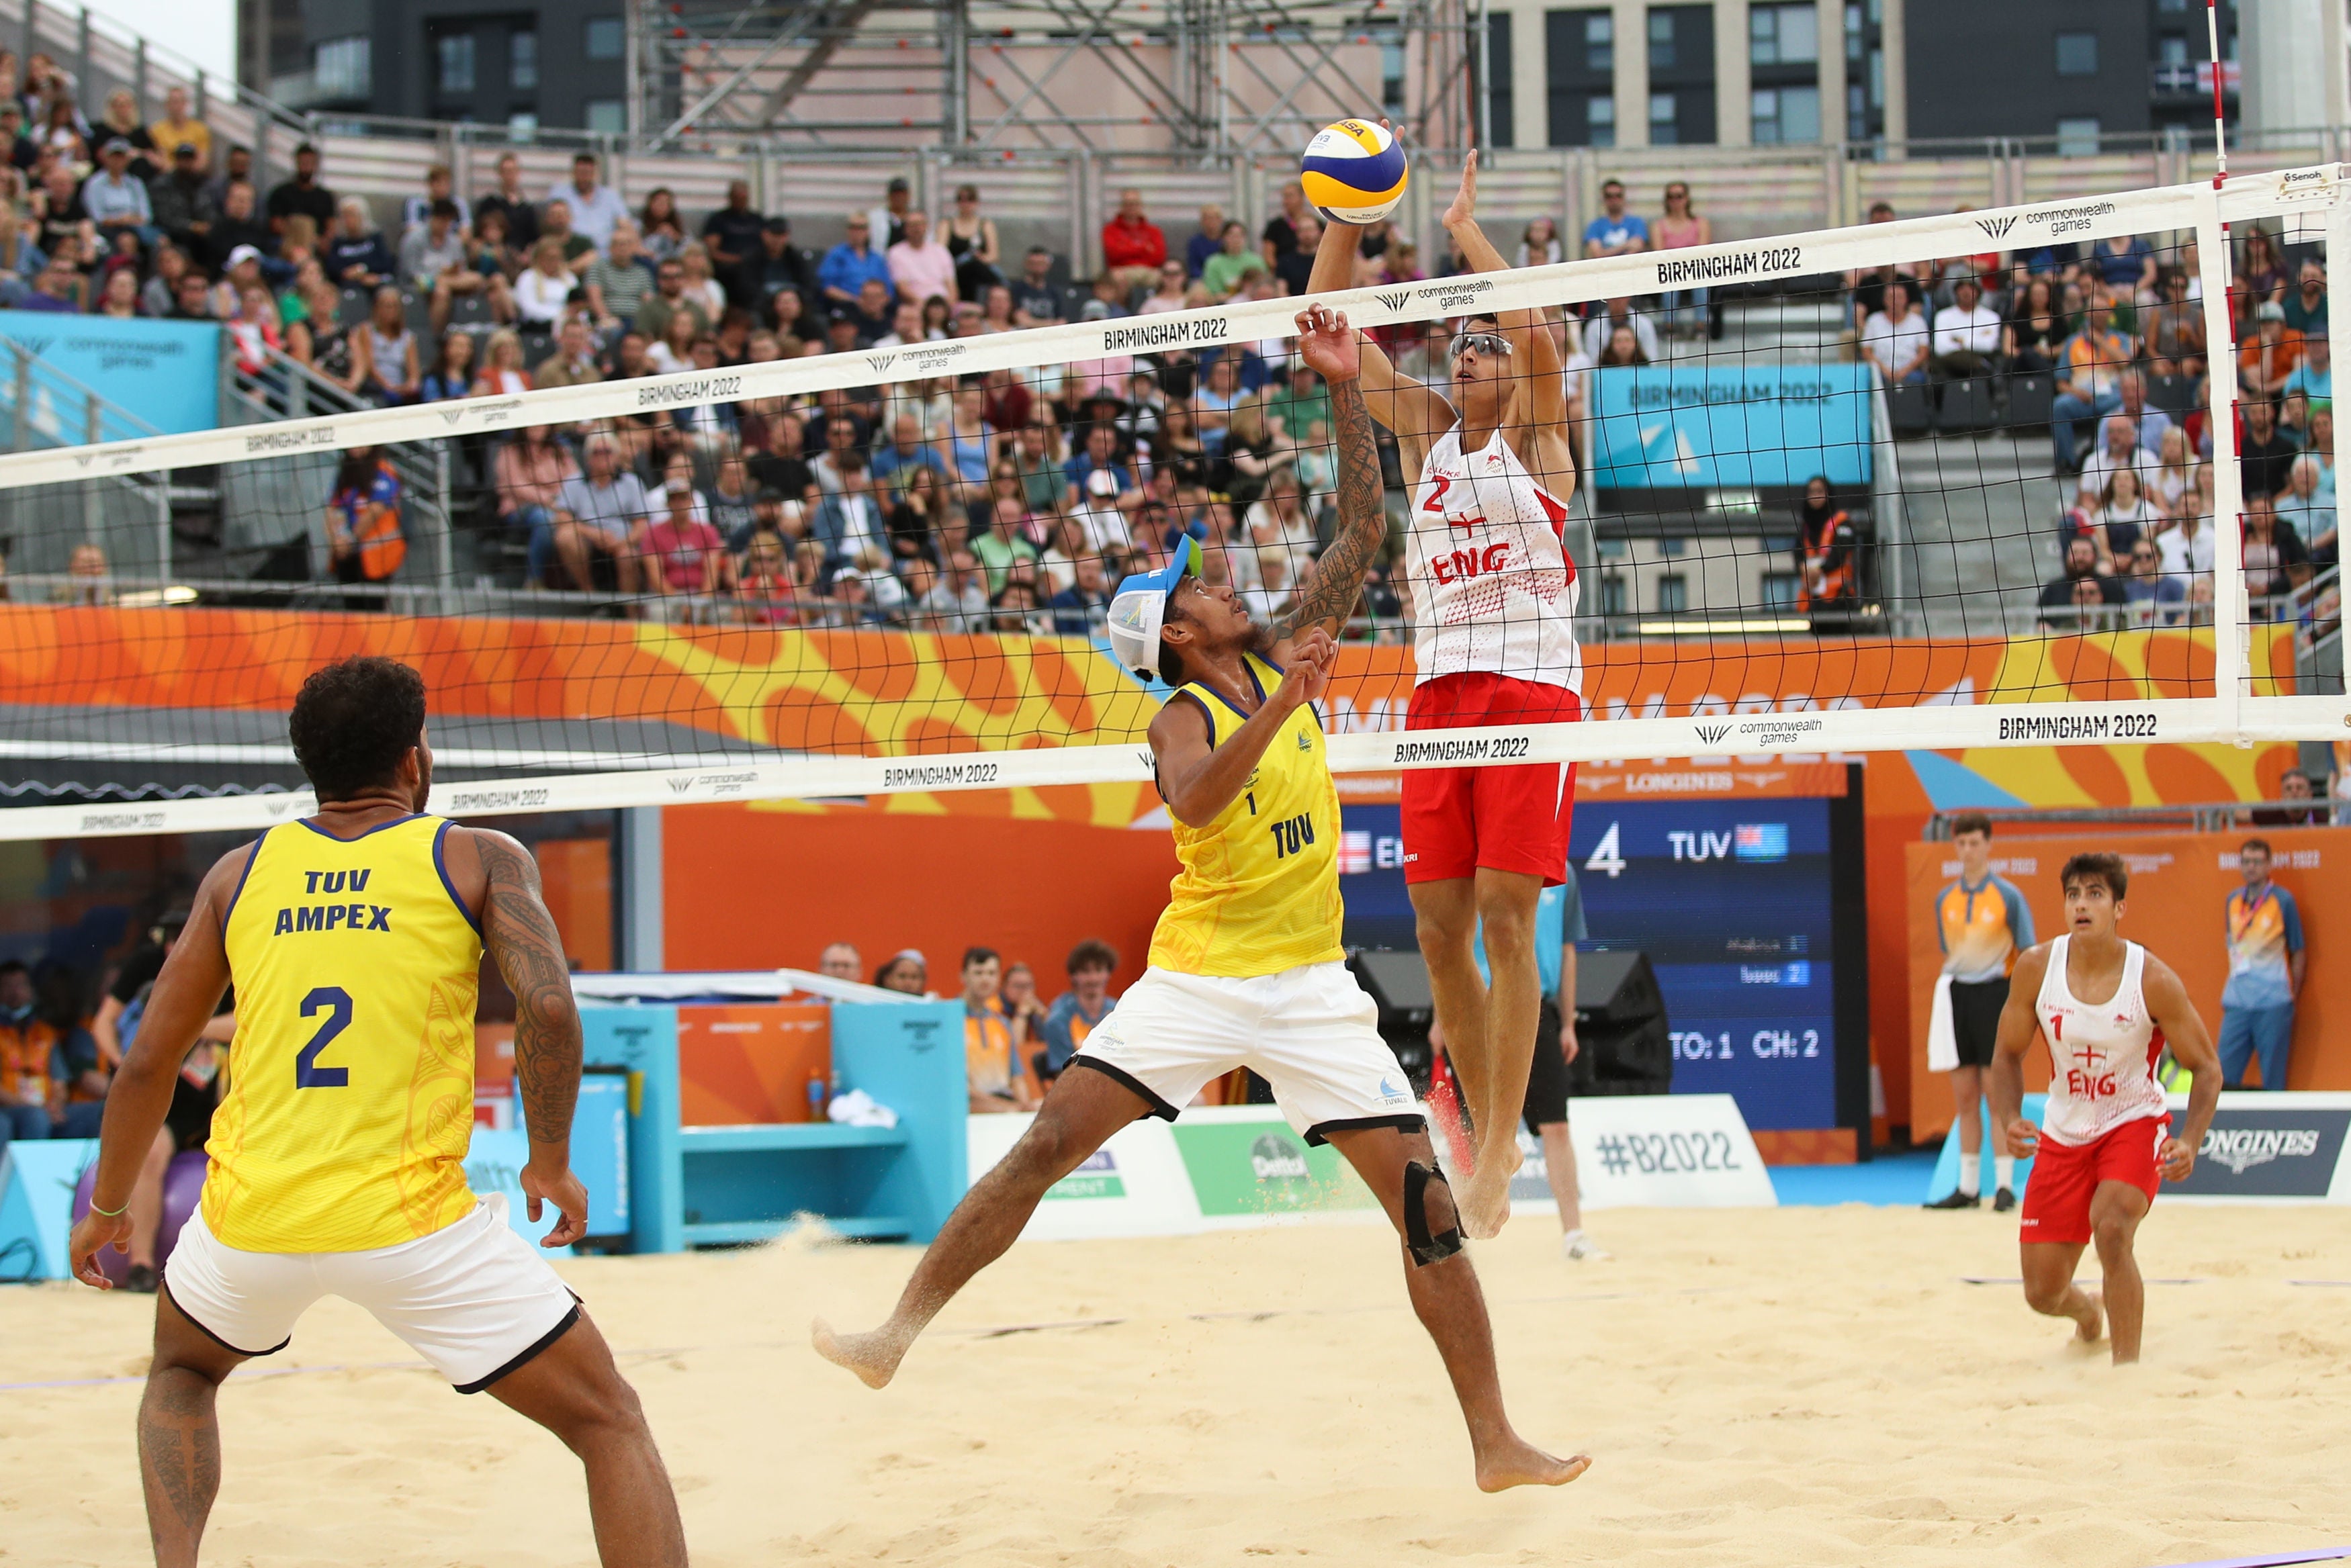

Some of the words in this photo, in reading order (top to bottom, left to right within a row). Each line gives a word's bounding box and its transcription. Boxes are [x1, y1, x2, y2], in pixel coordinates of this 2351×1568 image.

[2291, 171, 2322, 181] Senoh
[2026, 201, 2115, 224] commonwealth
[2051, 217, 2092, 237] games
[1657, 252, 1759, 285] BIRMINGHAM
[1761, 246, 1801, 273] 2022
[1417, 279, 1494, 299] commonwealth
[1440, 292, 1474, 310] games
[1104, 322, 1190, 350] BIRMINGHAM
[1193, 318, 1228, 340] 2022
[902, 344, 966, 361] commonwealth
[918, 356, 948, 372] games
[638, 380, 710, 406] BIRMINGHAM
[712, 376, 742, 396] 2022
[1628, 384, 1771, 407] BIRMINGHAM
[1774, 383, 1832, 406] 2022
[1423, 475, 1450, 512] 2
[1431, 543, 1509, 586] ENG
[1740, 719, 1822, 734] commonwealth
[2000, 717, 2109, 740] BIRMINGHAM
[2114, 714, 2157, 737] 2022
[1394, 739, 1489, 763] BIRMINGHAM
[1491, 737, 1529, 758] 2022
[1760, 732, 1798, 747] games
[699, 772, 759, 785] commonwealth
[883, 765, 963, 787] BIRMINGHAM
[965, 763, 997, 782] 2022
[1625, 772, 1734, 792] LONGINES
[450, 790, 519, 811] BIRMINGHAM
[1245, 791, 1256, 815] 1
[1270, 811, 1315, 859] TUV
[1667, 830, 1732, 862] TUV
[1403, 853, 1418, 864] KRI
[1585, 820, 1627, 878] 4
[305, 869, 371, 893] TUV
[274, 904, 392, 936] AMPEX
[1787, 963, 1800, 983] 2
[296, 986, 353, 1089] 2
[2050, 1015, 2062, 1041] 1
[1667, 1031, 1712, 1060] TO:
[1718, 1031, 1734, 1059] 1
[1752, 1029, 1798, 1058] CH:
[1803, 1029, 1819, 1058] 2
[2067, 1068, 2116, 1102] ENG
[1595, 1131, 1741, 1175] #B2022
[2197, 1128, 2320, 1156] ONGINES
